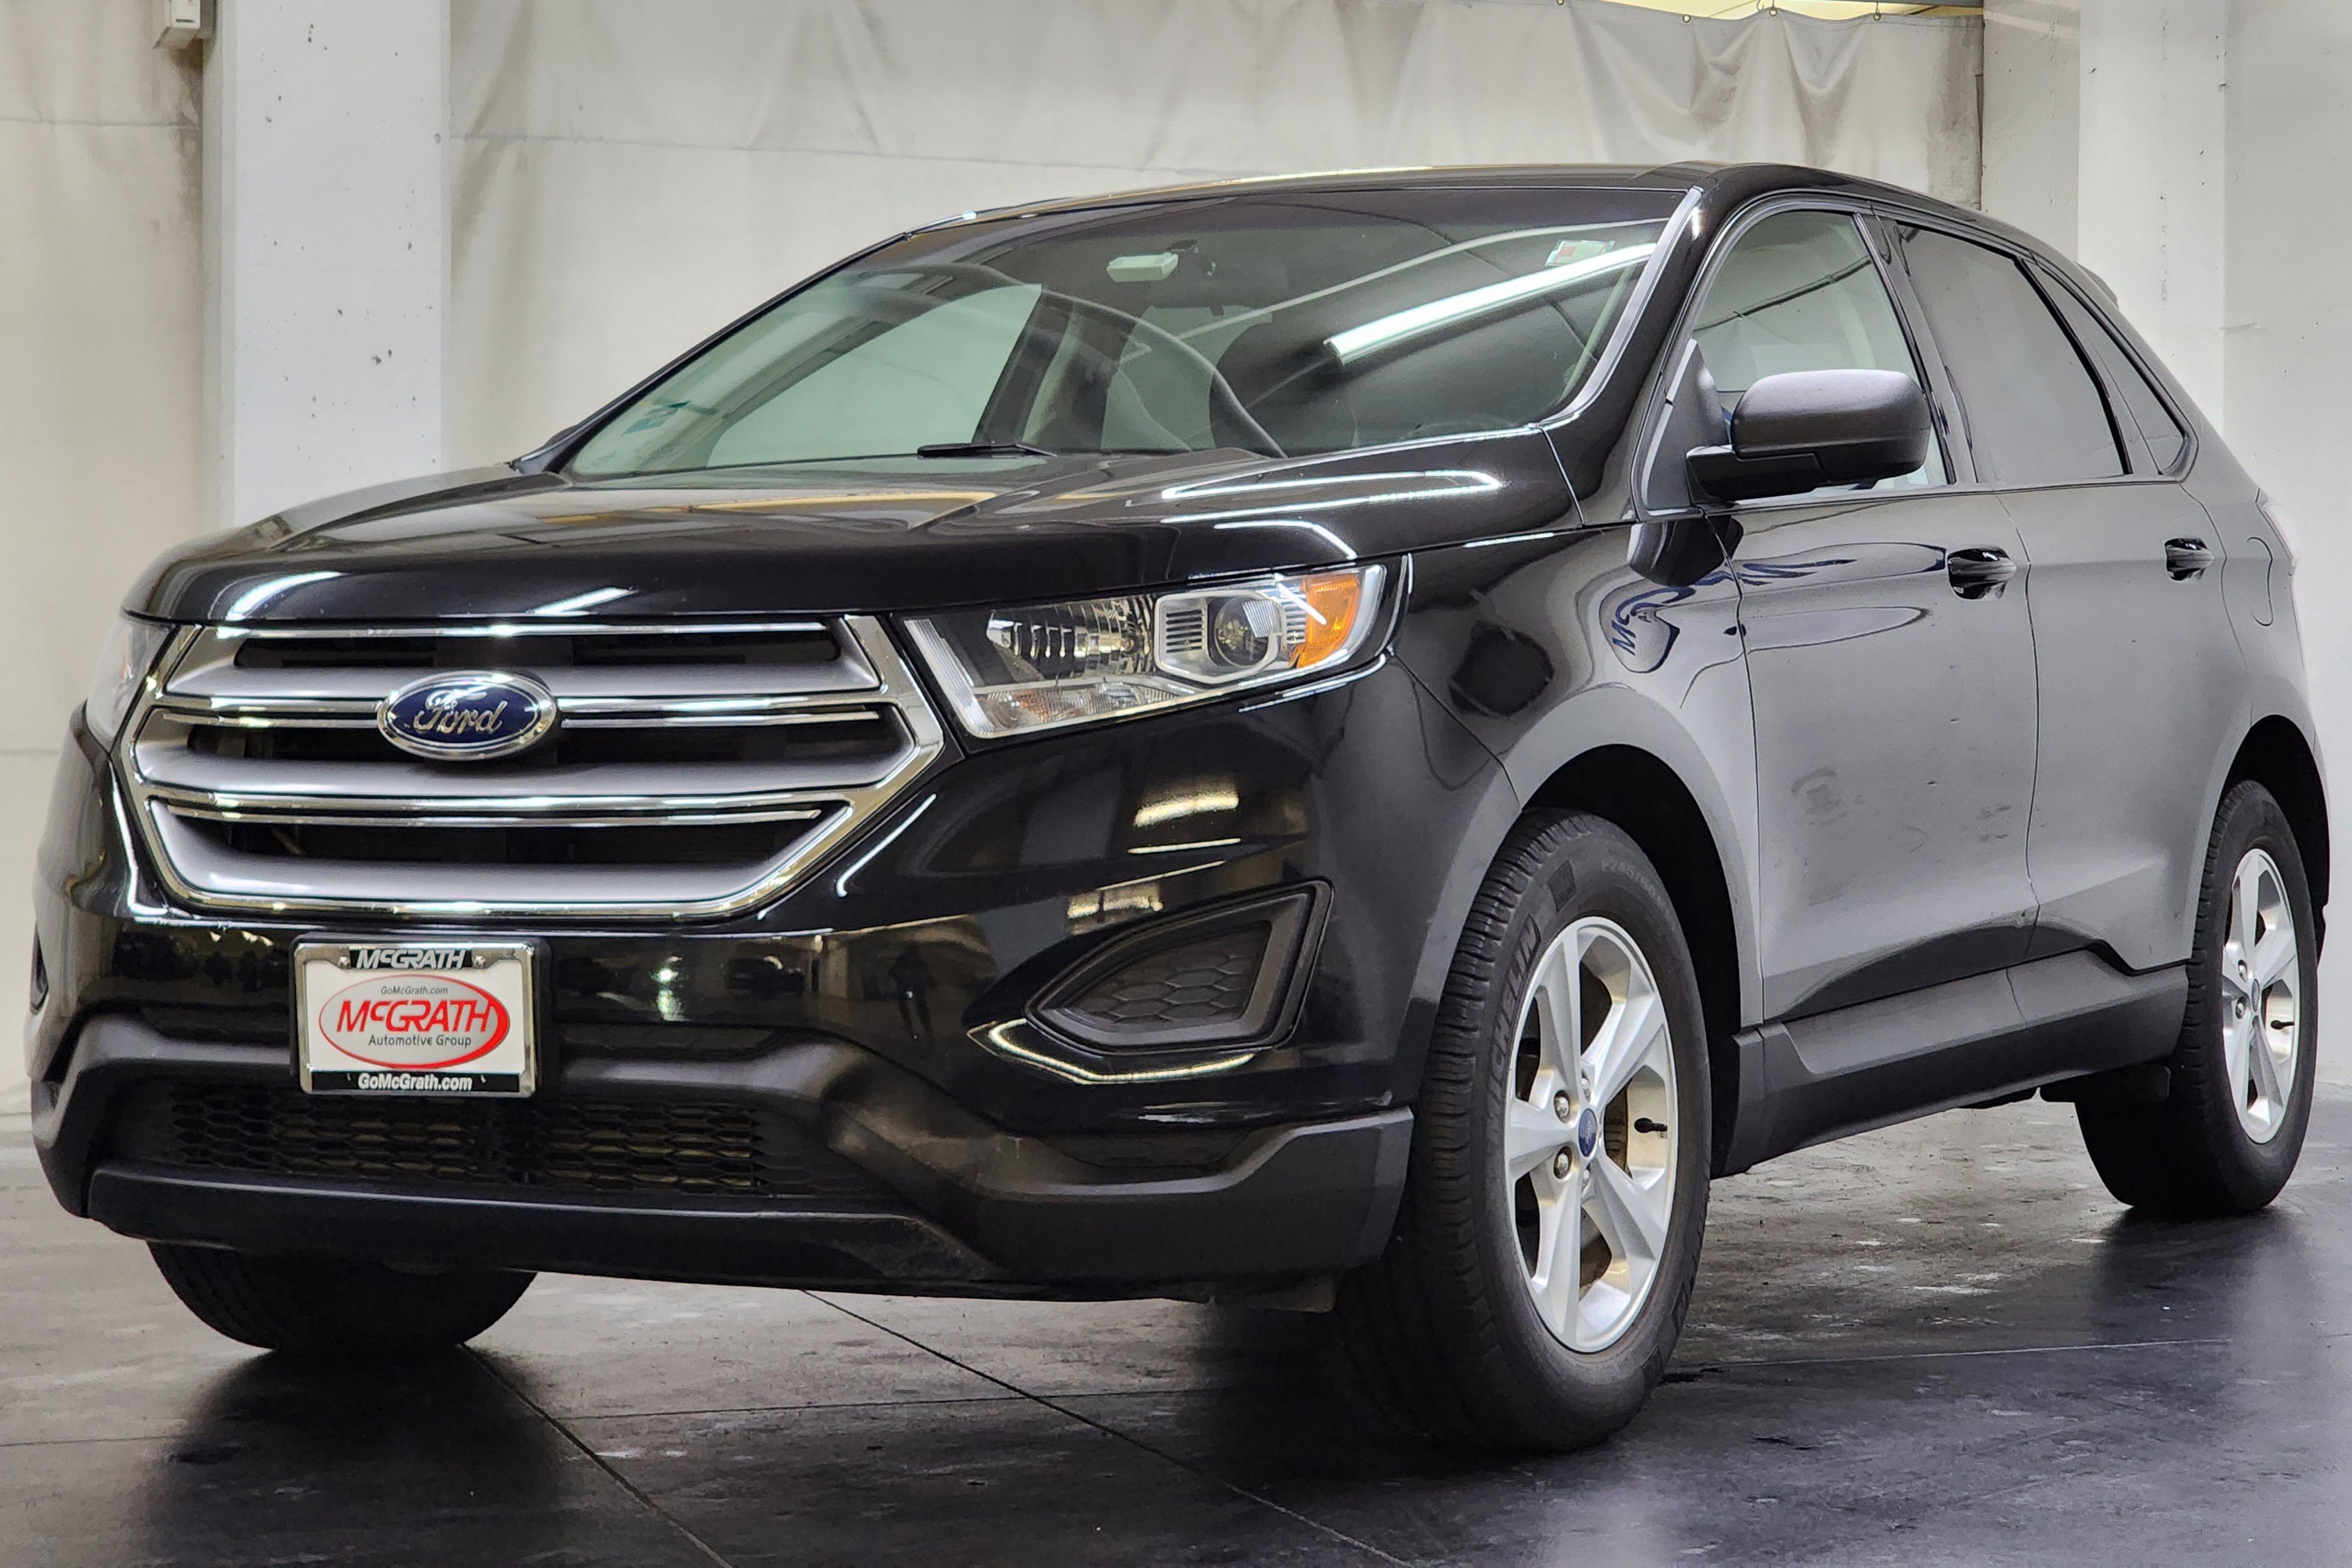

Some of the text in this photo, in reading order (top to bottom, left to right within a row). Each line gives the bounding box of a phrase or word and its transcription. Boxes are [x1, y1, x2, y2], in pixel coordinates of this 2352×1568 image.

[413, 689, 508, 734] Ford
[381, 986, 448, 996] GoMcGrath.com
[368, 1034, 472, 1049] Automotive Group
[357, 1073, 473, 1091] GoMcGrath.com
